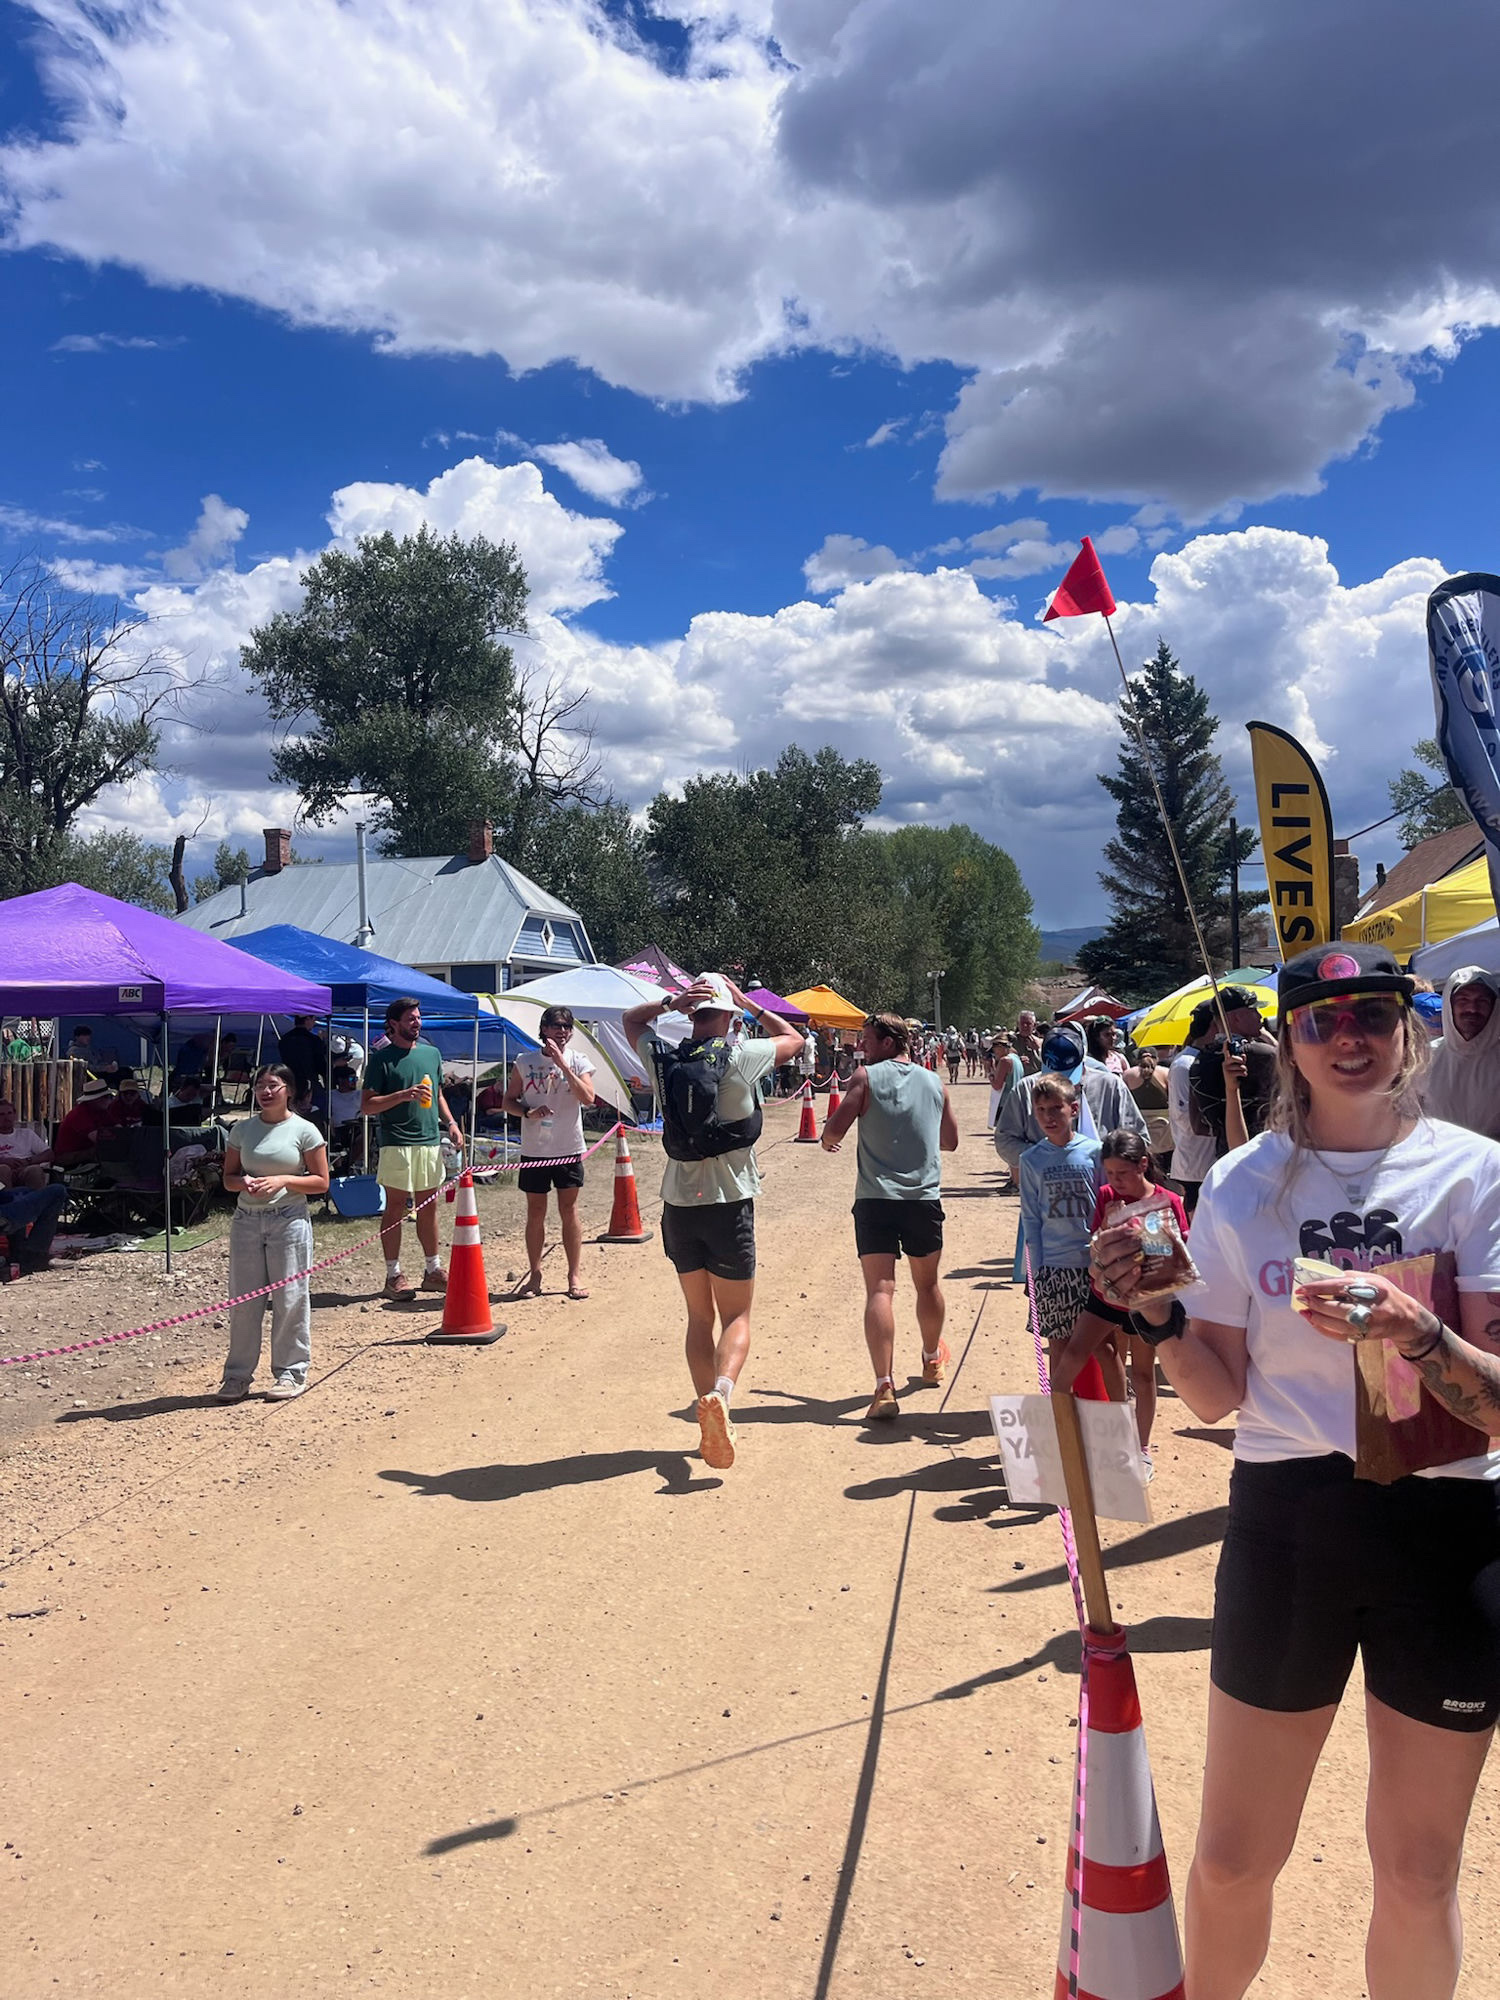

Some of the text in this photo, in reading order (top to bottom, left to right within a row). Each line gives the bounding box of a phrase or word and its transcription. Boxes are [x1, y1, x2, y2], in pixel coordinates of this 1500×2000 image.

[1271, 783, 1315, 943] LIVES
[121, 988, 141, 998] ABC
[1046, 1181, 1088, 1195] TRAIL
[1442, 1699, 1487, 1709] BROOKS
